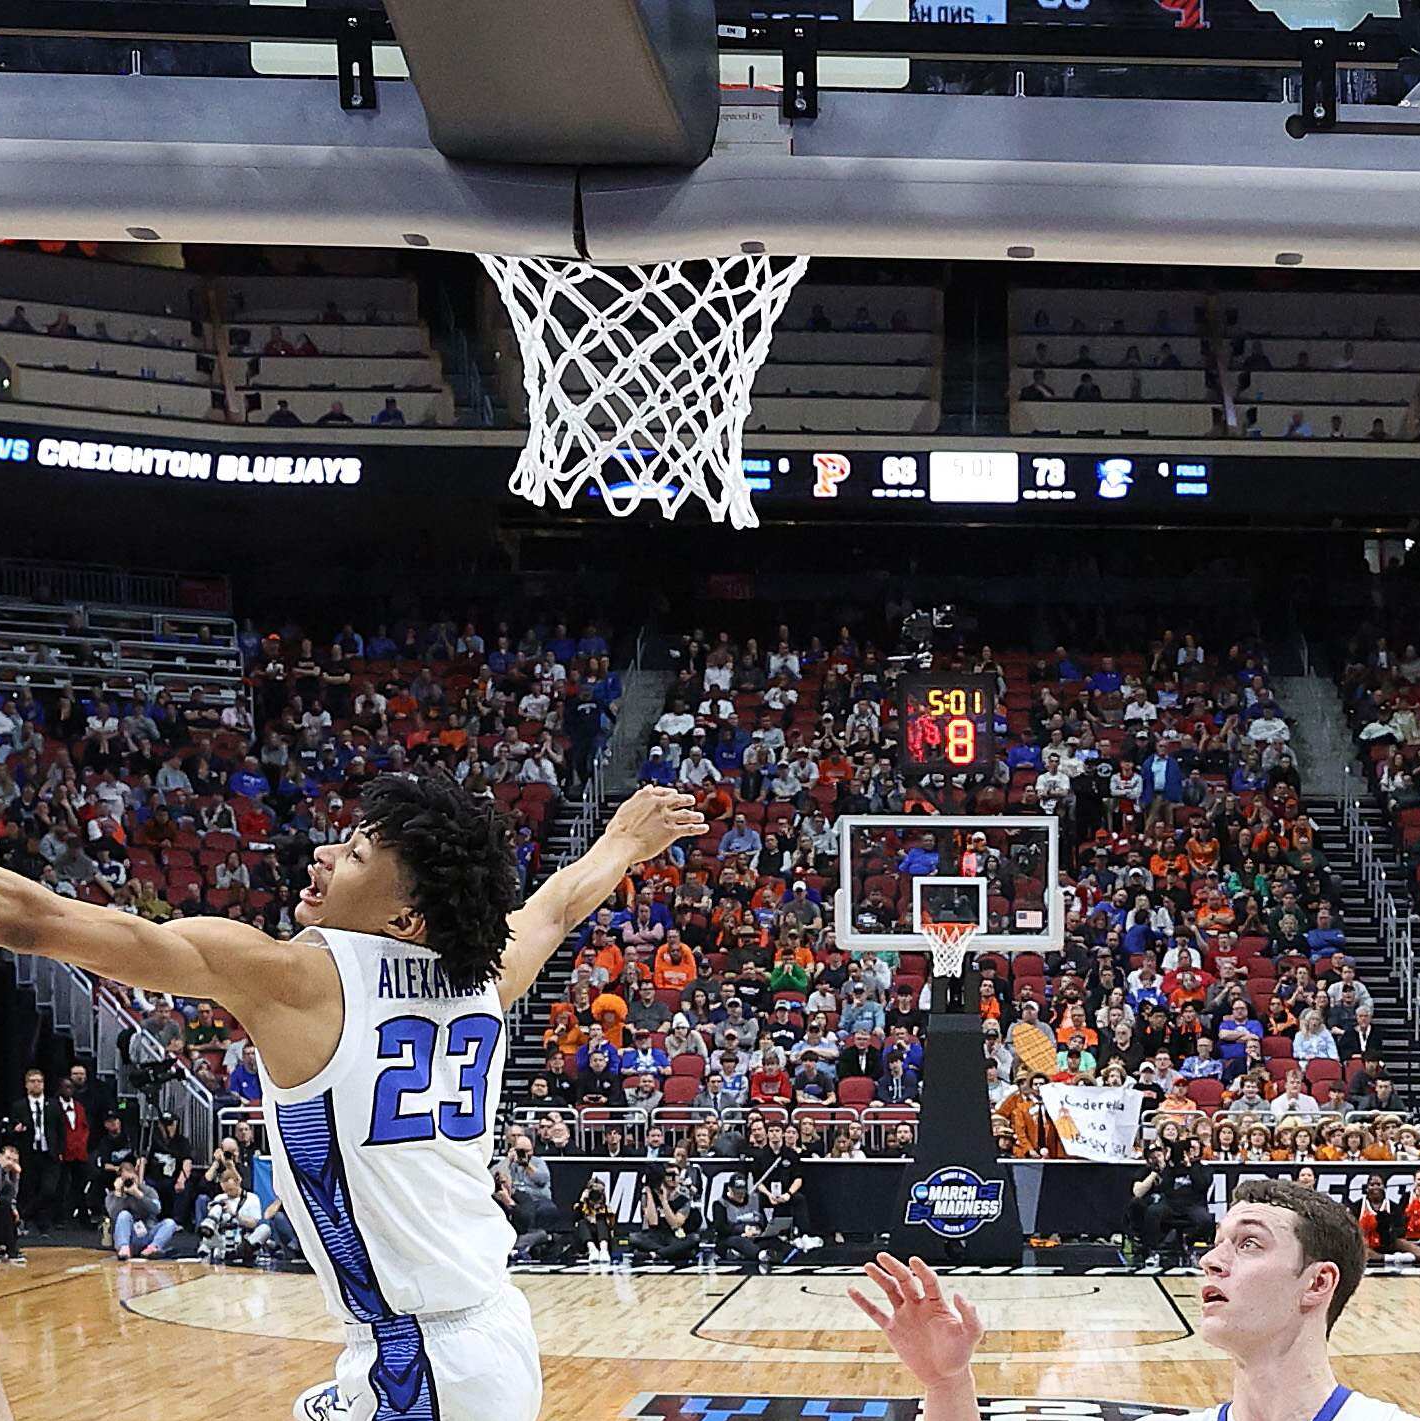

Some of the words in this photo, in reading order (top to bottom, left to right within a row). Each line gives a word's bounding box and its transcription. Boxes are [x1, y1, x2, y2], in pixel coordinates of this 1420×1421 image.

[37, 438, 212, 480] CREIGHTON
[216, 455, 362, 484] BLUEJAYS
[928, 690, 982, 716] 5:01
[947, 718, 975, 765] 8
[379, 956, 486, 999] ALEXA
[360, 1012, 503, 1147] 23
[928, 1185, 978, 1201] MARCH
[933, 1200, 1000, 1216] MADNESS
